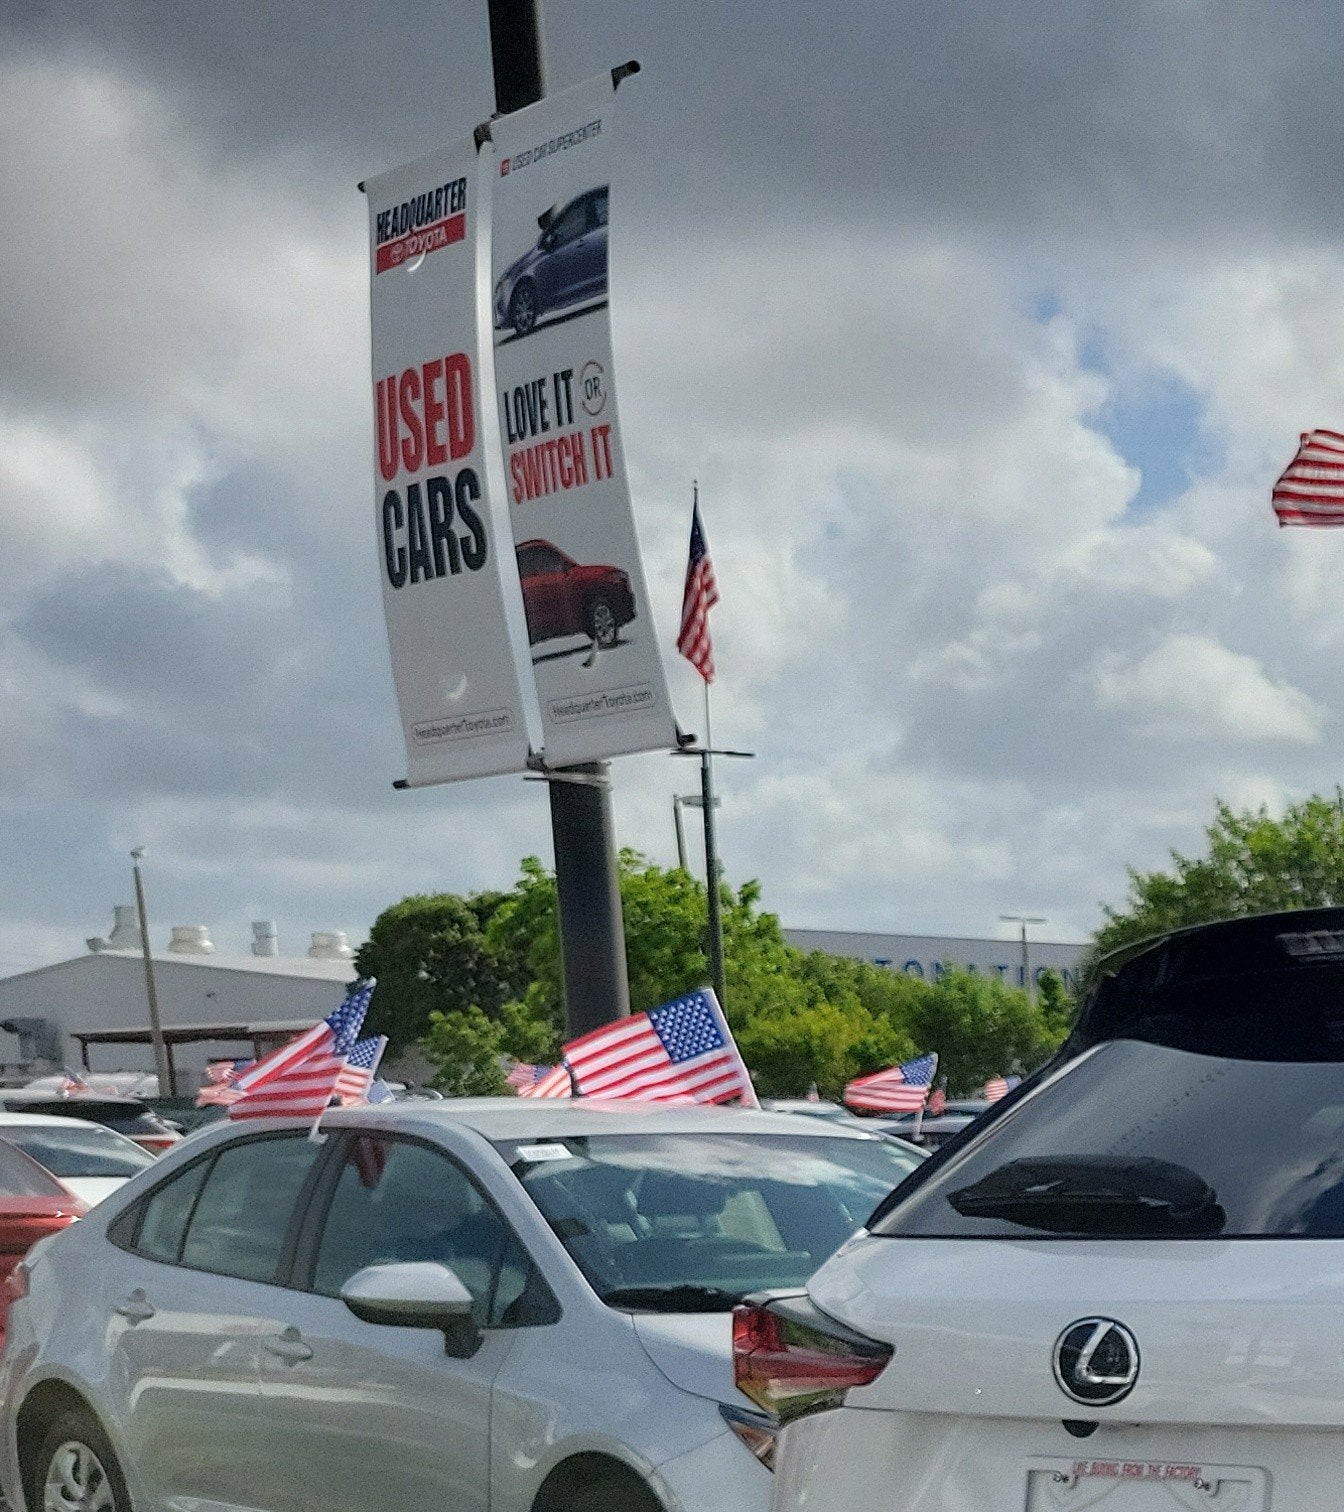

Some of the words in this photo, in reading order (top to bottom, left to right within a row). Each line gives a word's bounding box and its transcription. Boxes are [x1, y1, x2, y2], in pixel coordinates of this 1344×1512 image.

[376, 176, 467, 245] HEADQUARTER
[404, 225, 448, 256] TOYOTA
[376, 352, 476, 482] USED
[503, 377, 551, 445] LOVE
[553, 368, 574, 428] IT
[584, 376, 602, 401] OR
[510, 431, 589, 505] SWITCH
[591, 423, 614, 482] IT
[382, 466, 488, 590] CARS
